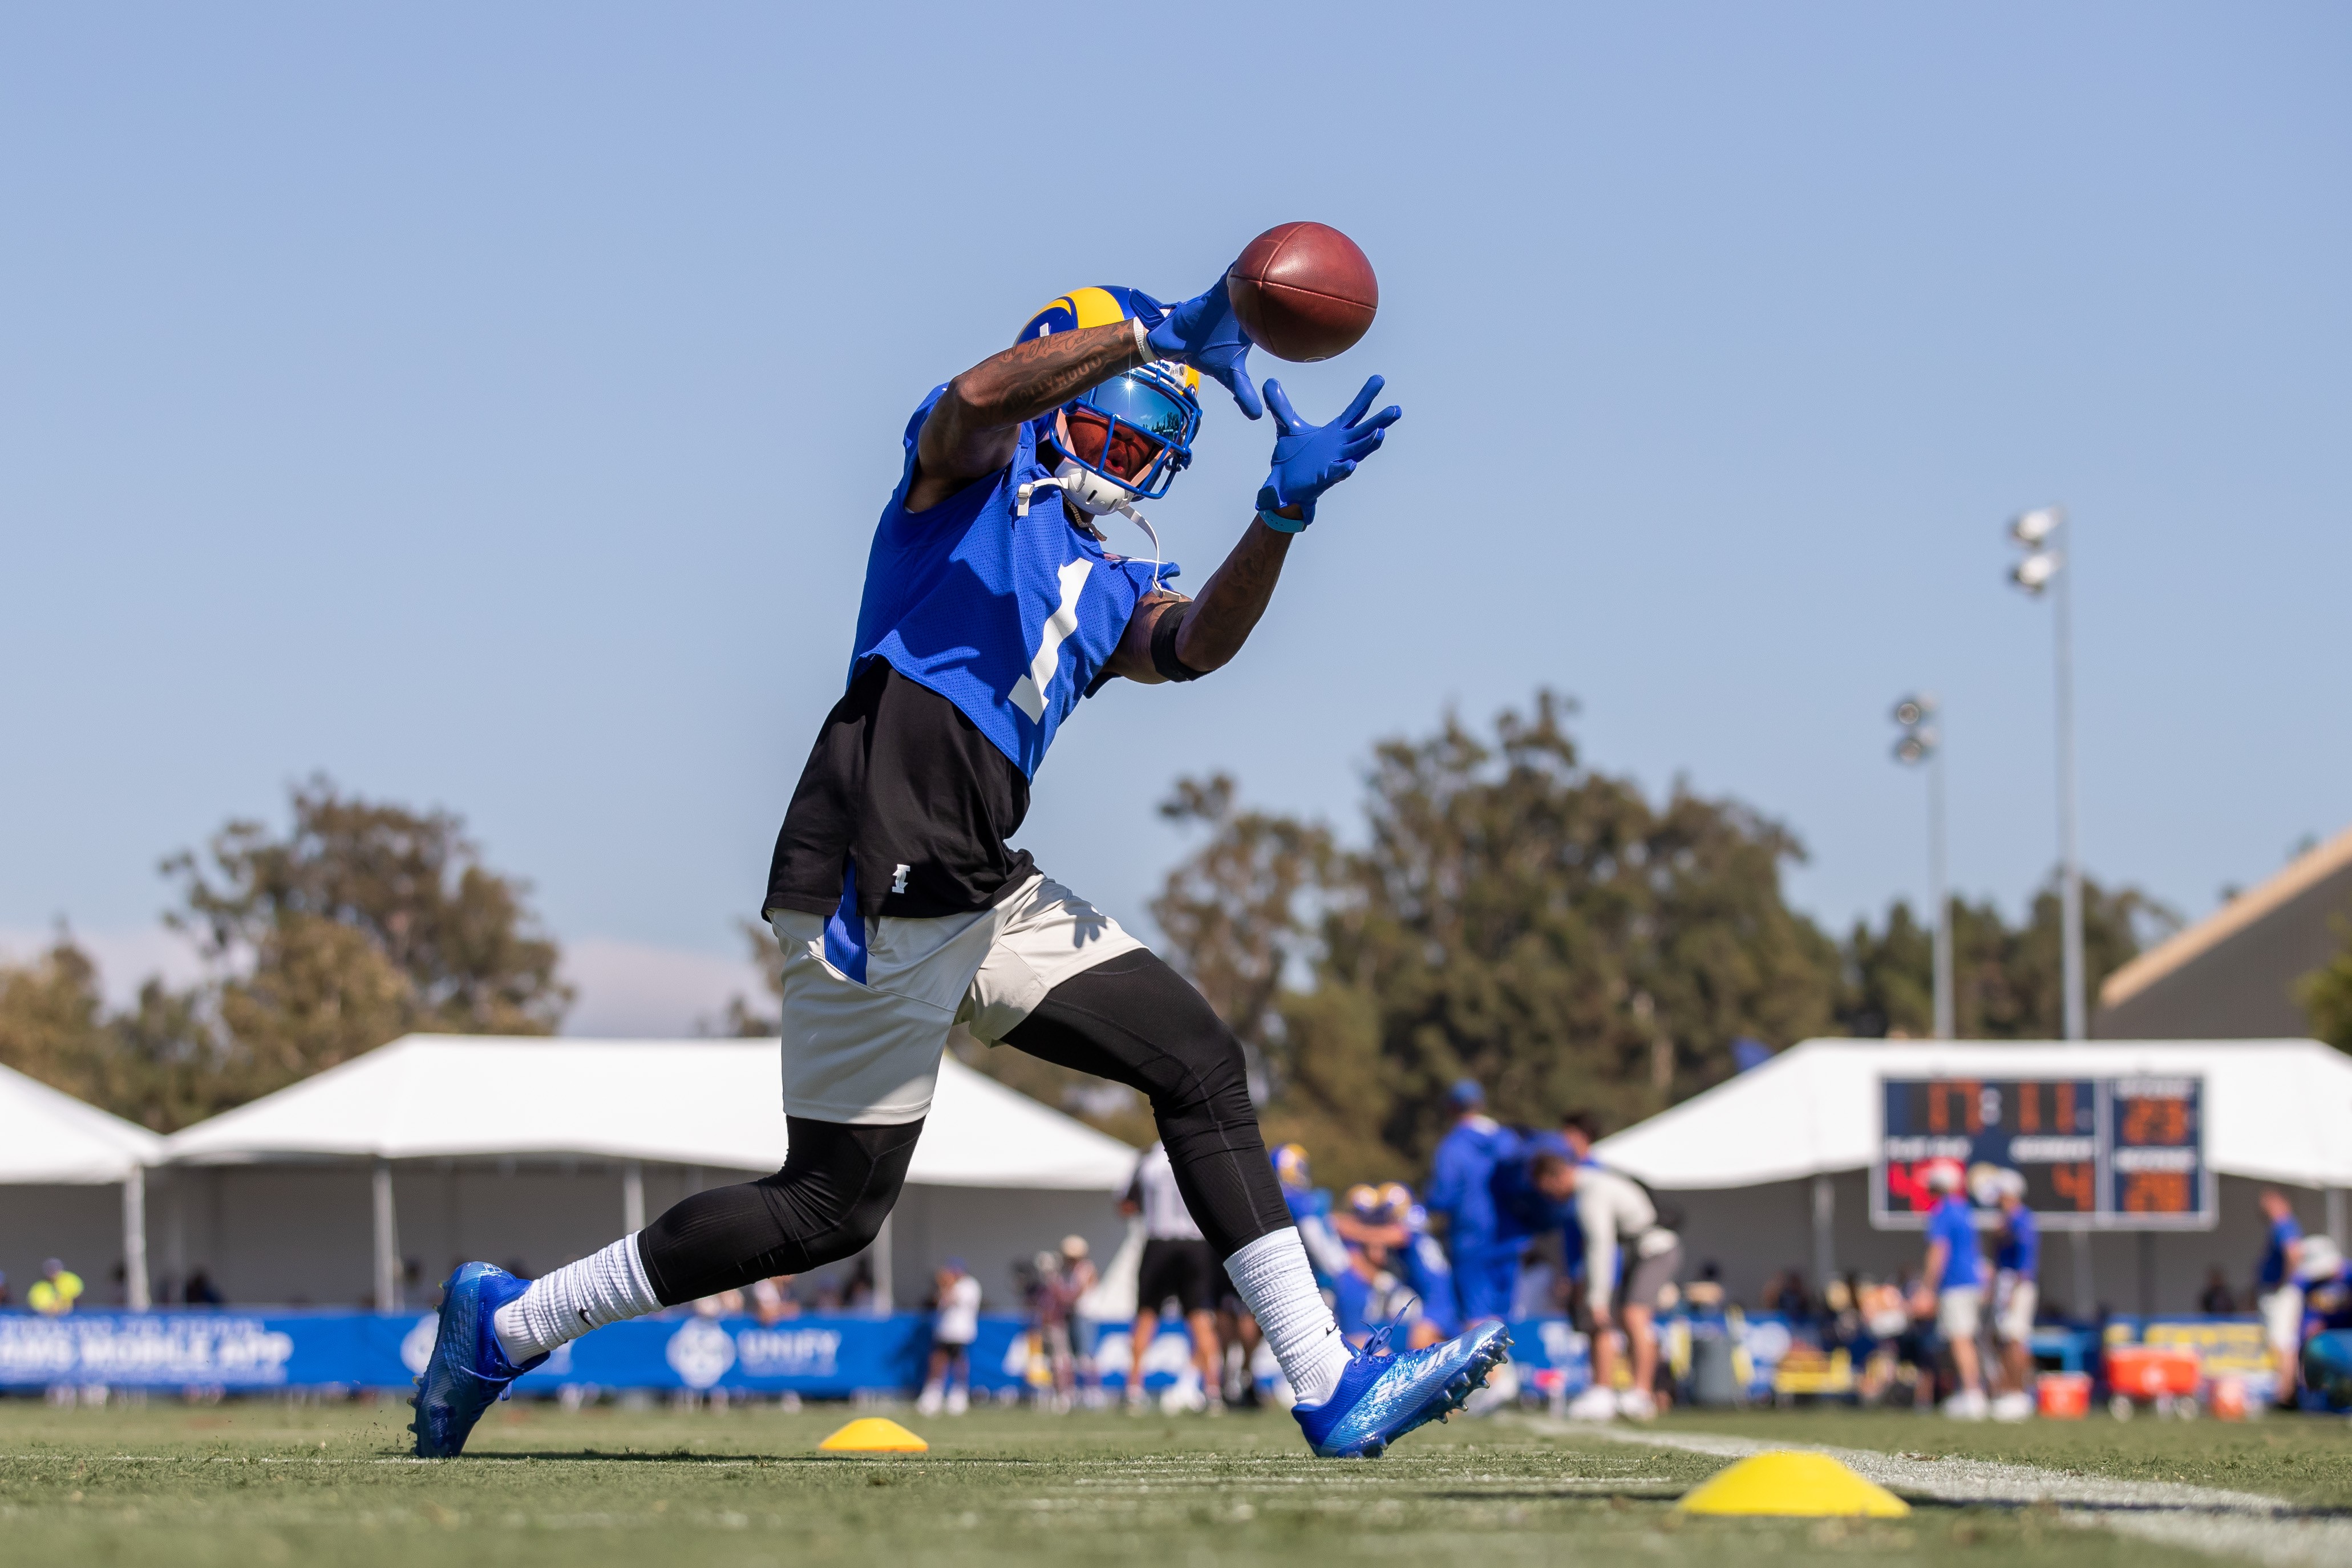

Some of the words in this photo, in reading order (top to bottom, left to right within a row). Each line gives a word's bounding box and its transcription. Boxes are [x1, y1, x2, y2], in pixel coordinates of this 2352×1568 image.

[1007, 557, 1094, 725] 1
[738, 1328, 841, 1362] UNIFY
[1437, 1360, 1446, 1368] JET
